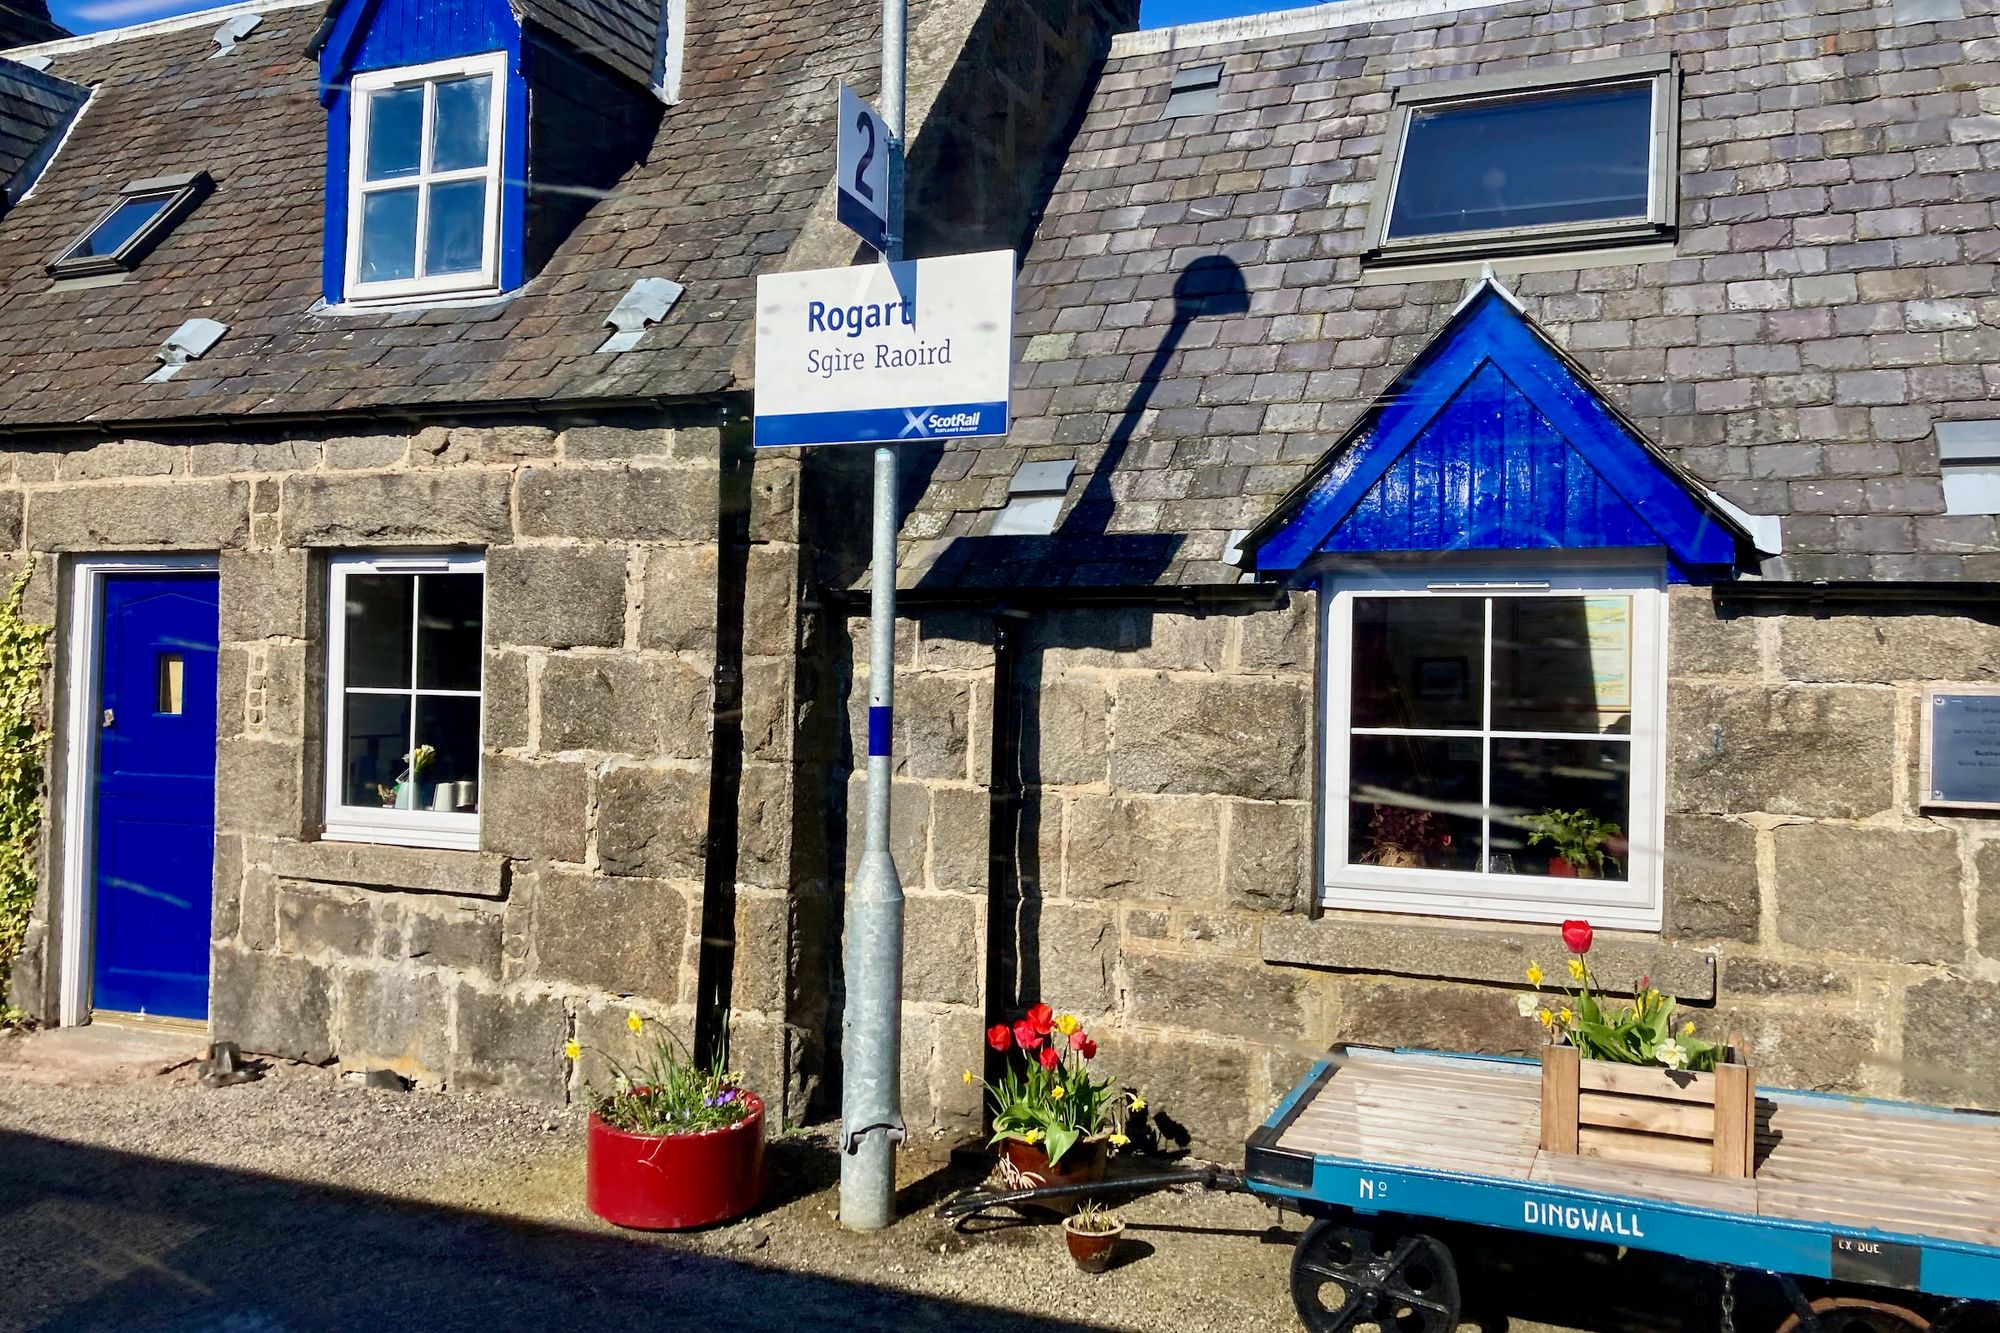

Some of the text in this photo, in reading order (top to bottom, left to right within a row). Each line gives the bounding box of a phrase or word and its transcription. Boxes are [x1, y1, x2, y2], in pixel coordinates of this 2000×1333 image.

[855, 111, 875, 203] 2
[808, 295, 913, 338] Rogart
[807, 338, 952, 379] Sgìre Raoird
[928, 411, 981, 428] ScotRail
[1524, 1201, 1645, 1237] DINGWALL
